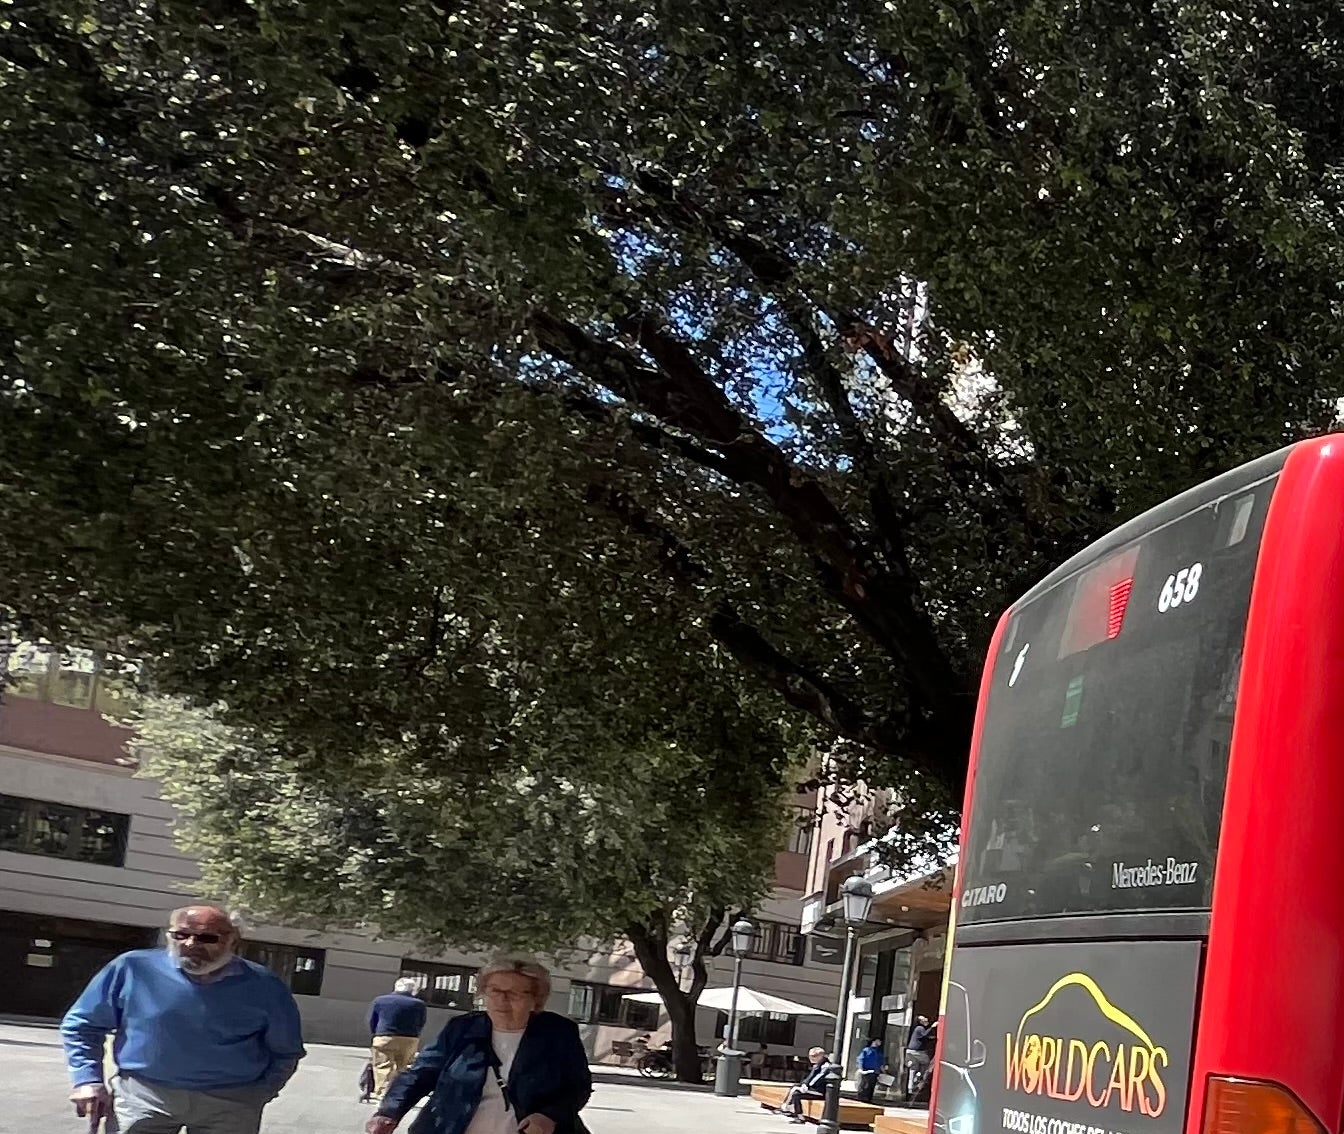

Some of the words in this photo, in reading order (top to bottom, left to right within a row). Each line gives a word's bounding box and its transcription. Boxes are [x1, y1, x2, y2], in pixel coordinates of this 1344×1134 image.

[1158, 562, 1202, 613] 658
[1112, 857, 1198, 888] Mercedes-Benz
[961, 883, 1007, 908] CITARO
[1006, 1032, 1168, 1118] WORLDCARS
[1002, 1107, 1029, 1134] TODOS
